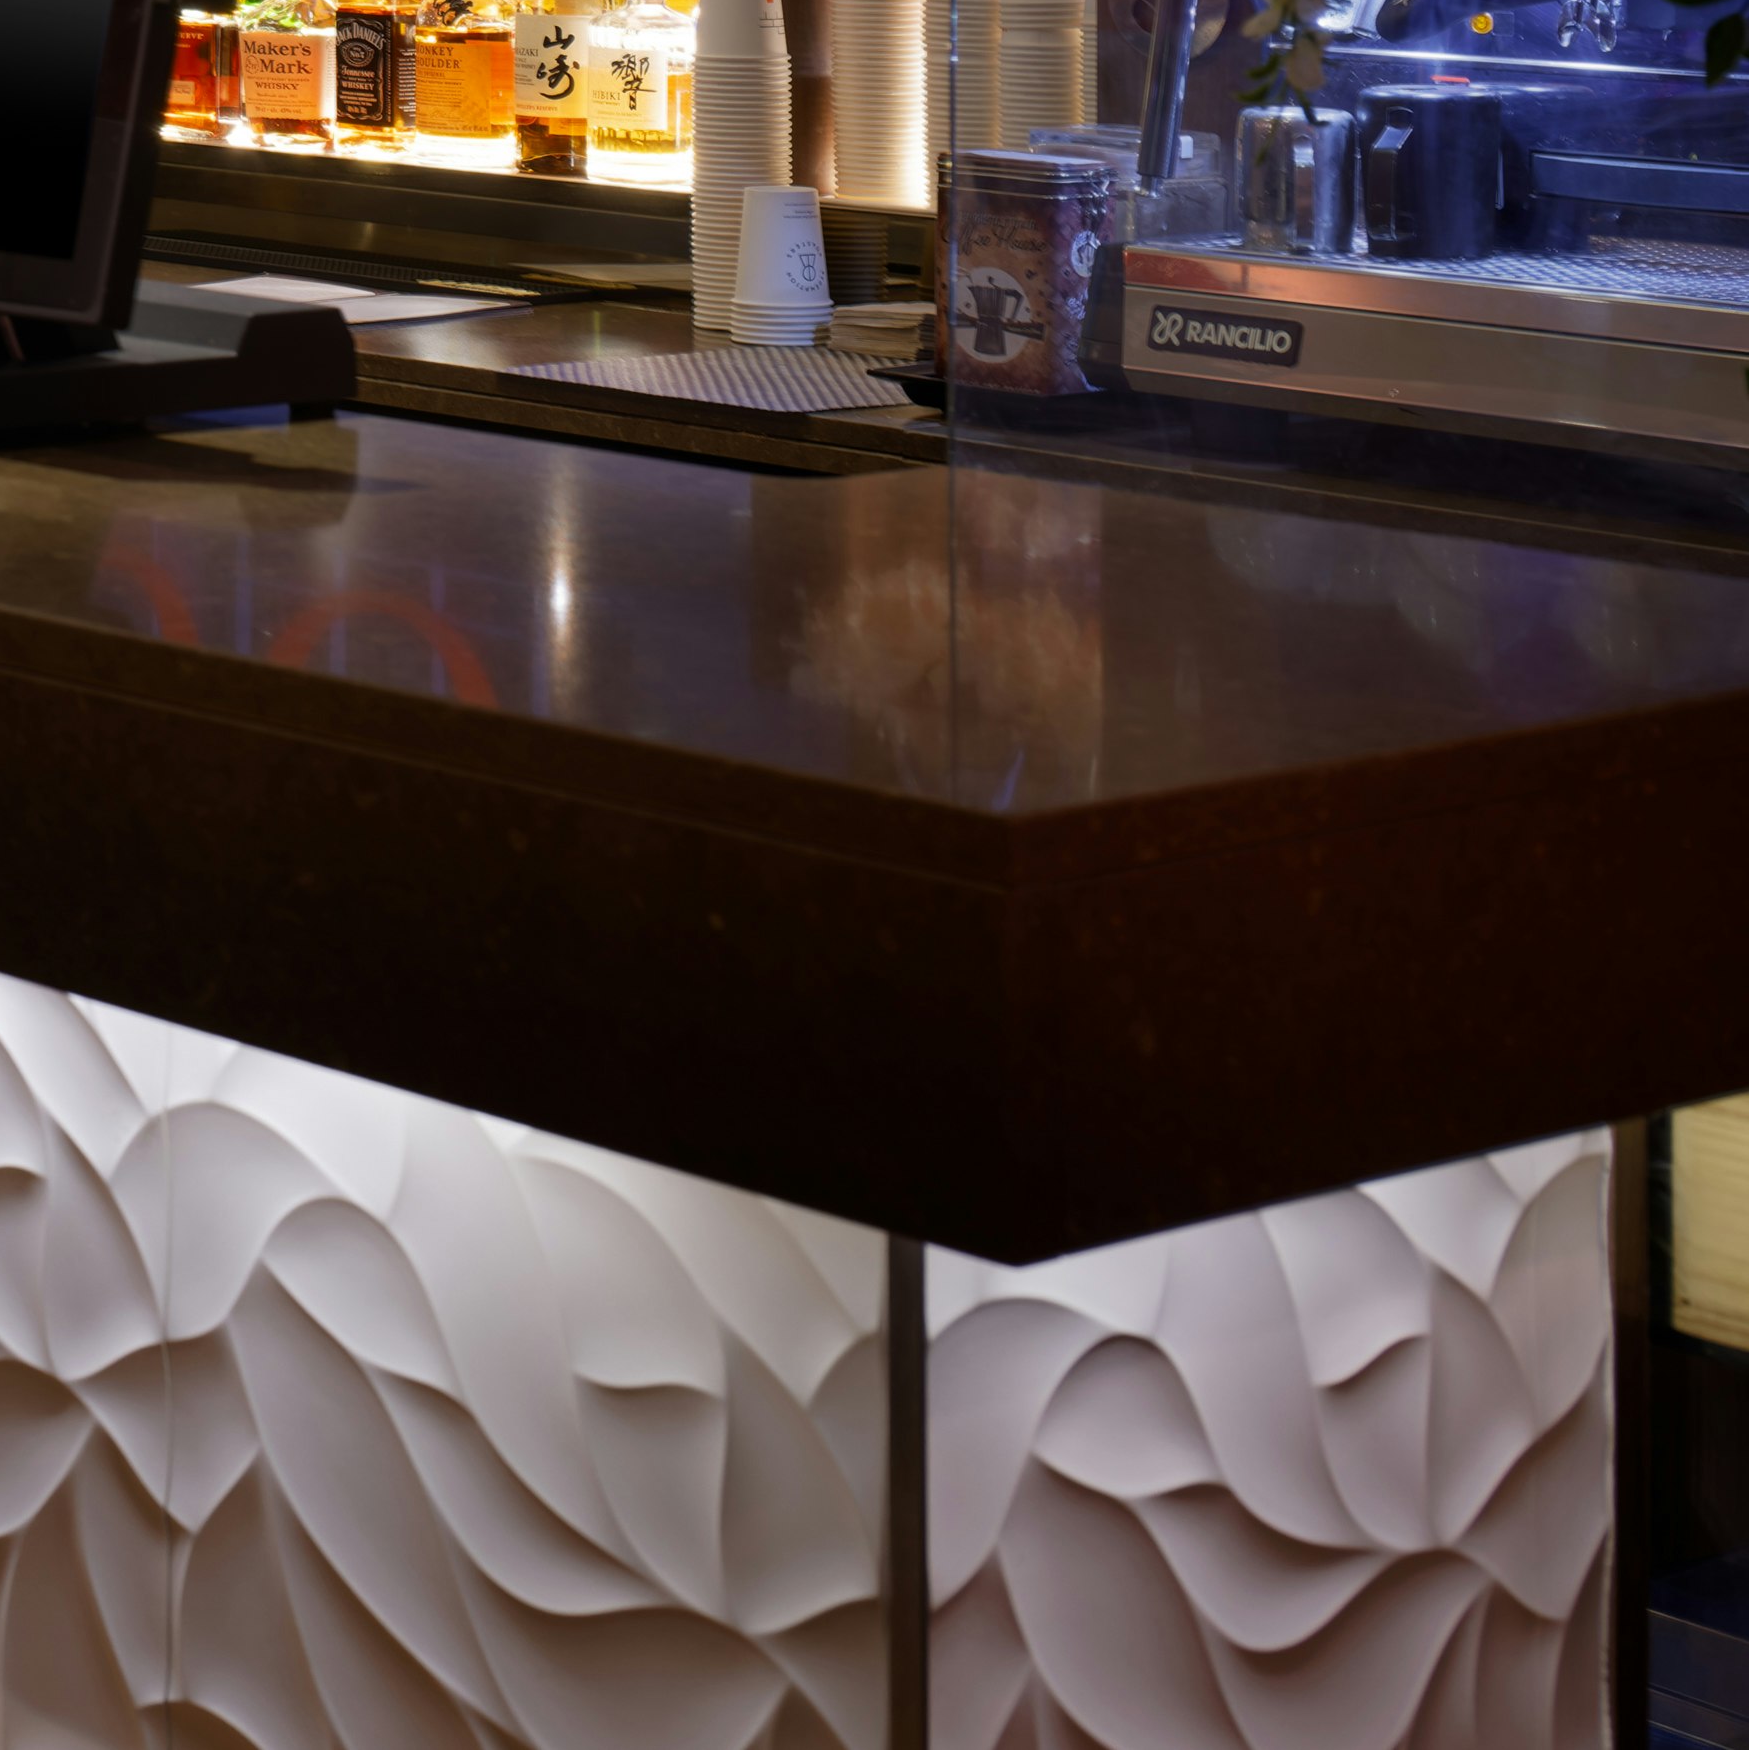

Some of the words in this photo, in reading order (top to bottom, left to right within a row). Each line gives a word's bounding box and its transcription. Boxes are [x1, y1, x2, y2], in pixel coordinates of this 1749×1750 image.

[352, 22, 387, 50] DANIEL'S
[243, 40, 312, 56] Maker's
[259, 58, 312, 75] Mark
[255, 81, 300, 91] WHISKY
[341, 81, 375, 91] WHISKEY
[592, 89, 621, 101] HIBIKI
[1186, 319, 1292, 354] RANCILIO
